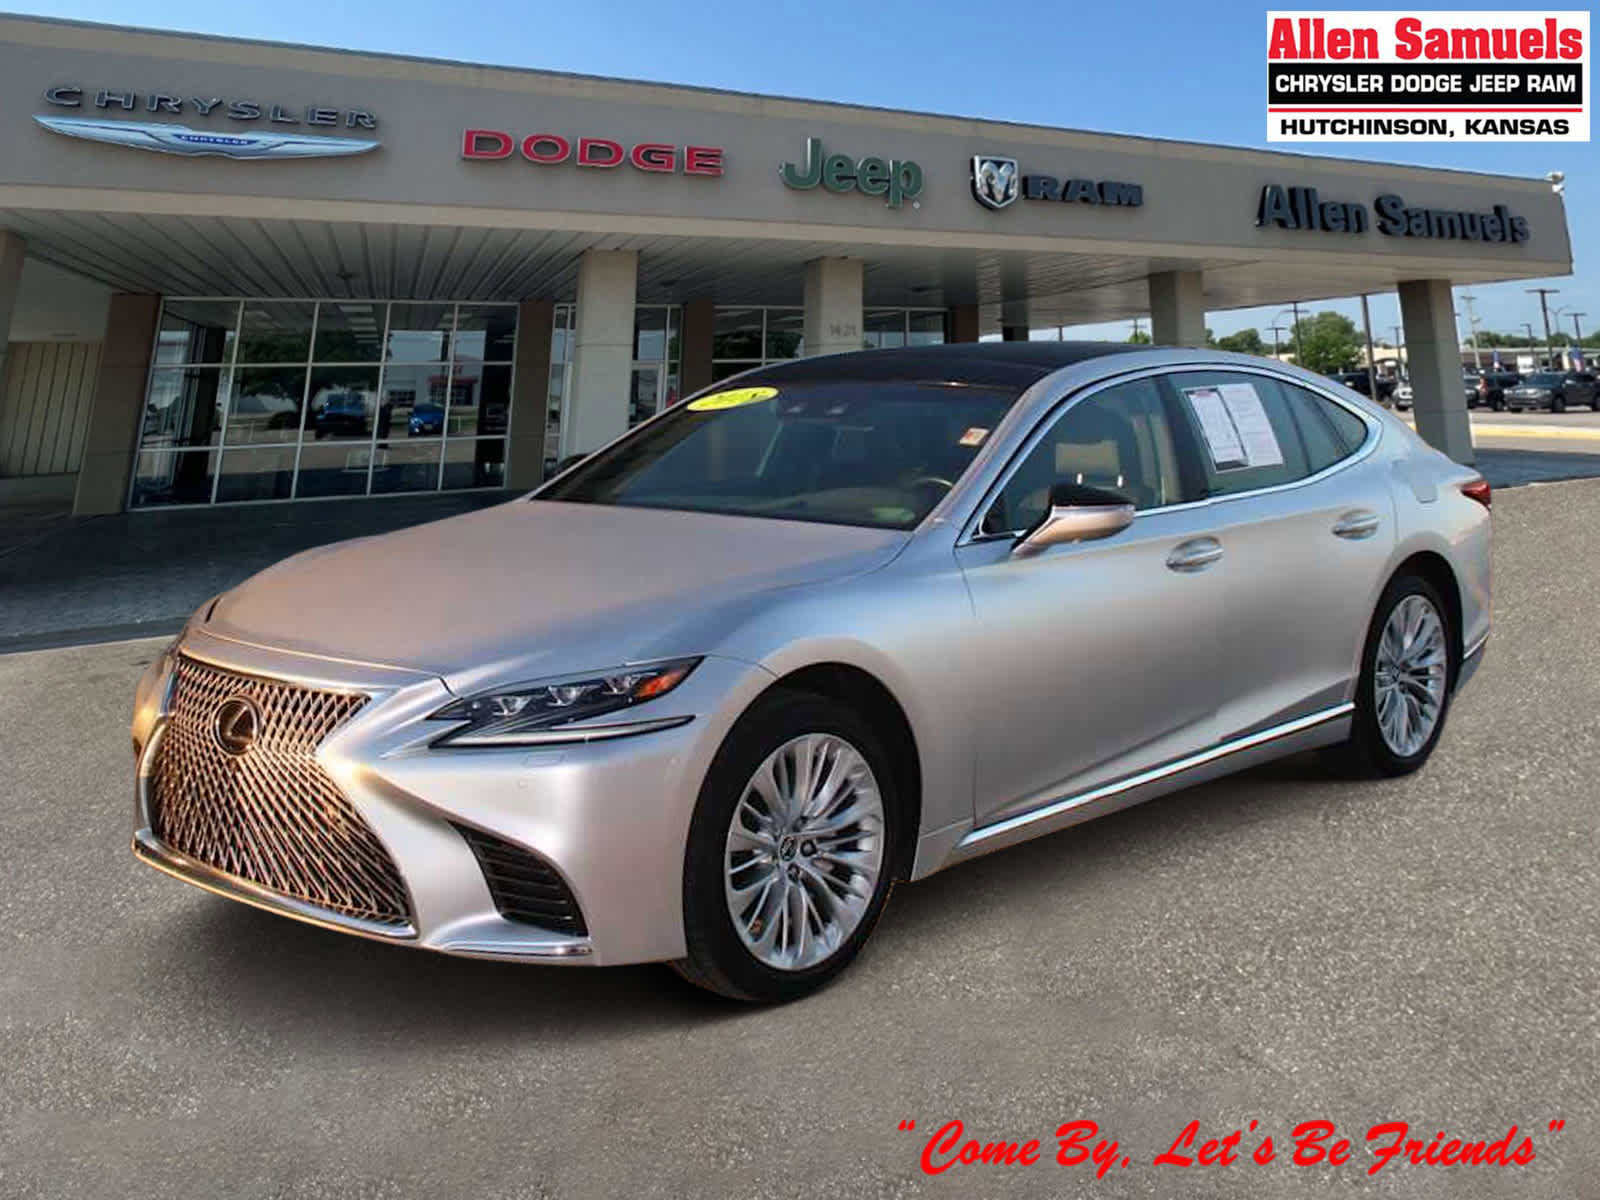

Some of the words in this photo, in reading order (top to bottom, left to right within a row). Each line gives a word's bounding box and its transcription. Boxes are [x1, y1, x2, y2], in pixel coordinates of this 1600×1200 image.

[43, 86, 378, 129] CHRYSLER
[461, 128, 726, 176] DODGE
[778, 137, 923, 208] Jeep
[1022, 174, 1144, 208] RAM
[1256, 184, 1369, 234] Allen
[1373, 193, 1531, 243] Samuels
